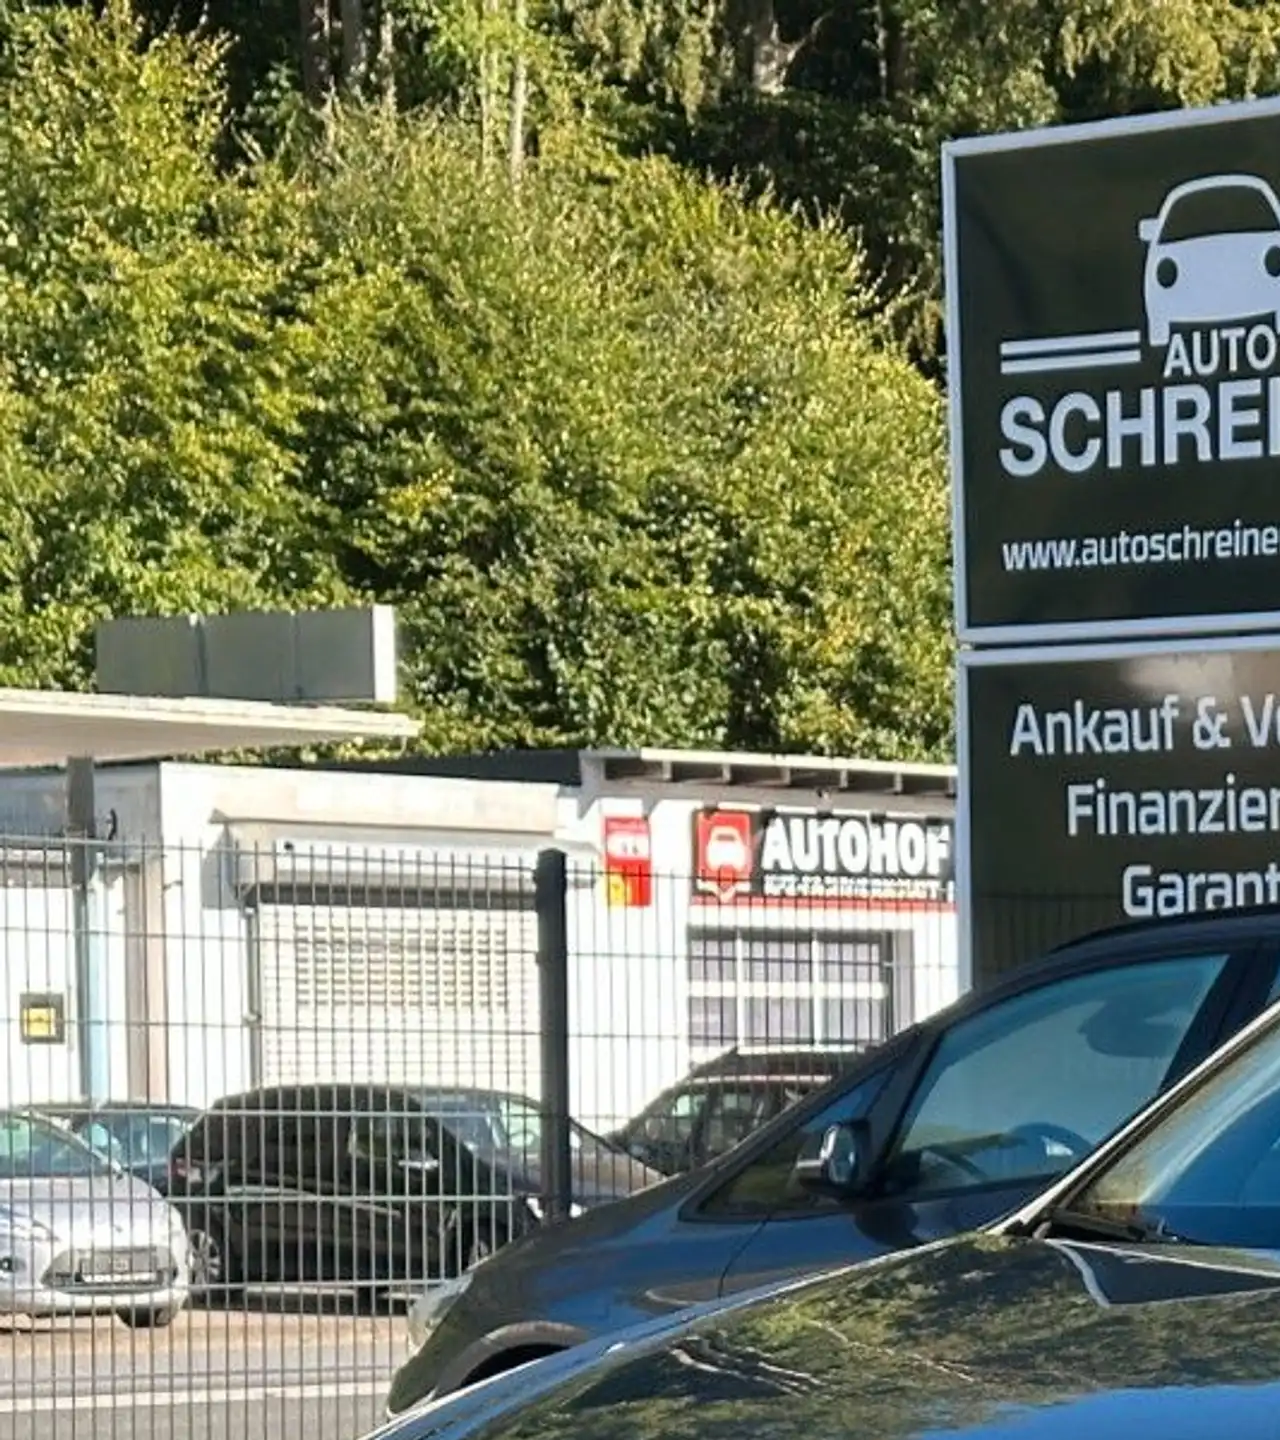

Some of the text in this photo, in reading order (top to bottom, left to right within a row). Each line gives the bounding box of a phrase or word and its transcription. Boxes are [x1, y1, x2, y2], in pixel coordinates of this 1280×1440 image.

[1163, 322, 1279, 379] AUTO
[1010, 693, 1180, 756] Ankauf
[1192, 697, 1231, 751] &
[761, 817, 950, 876] AUTOHOF
